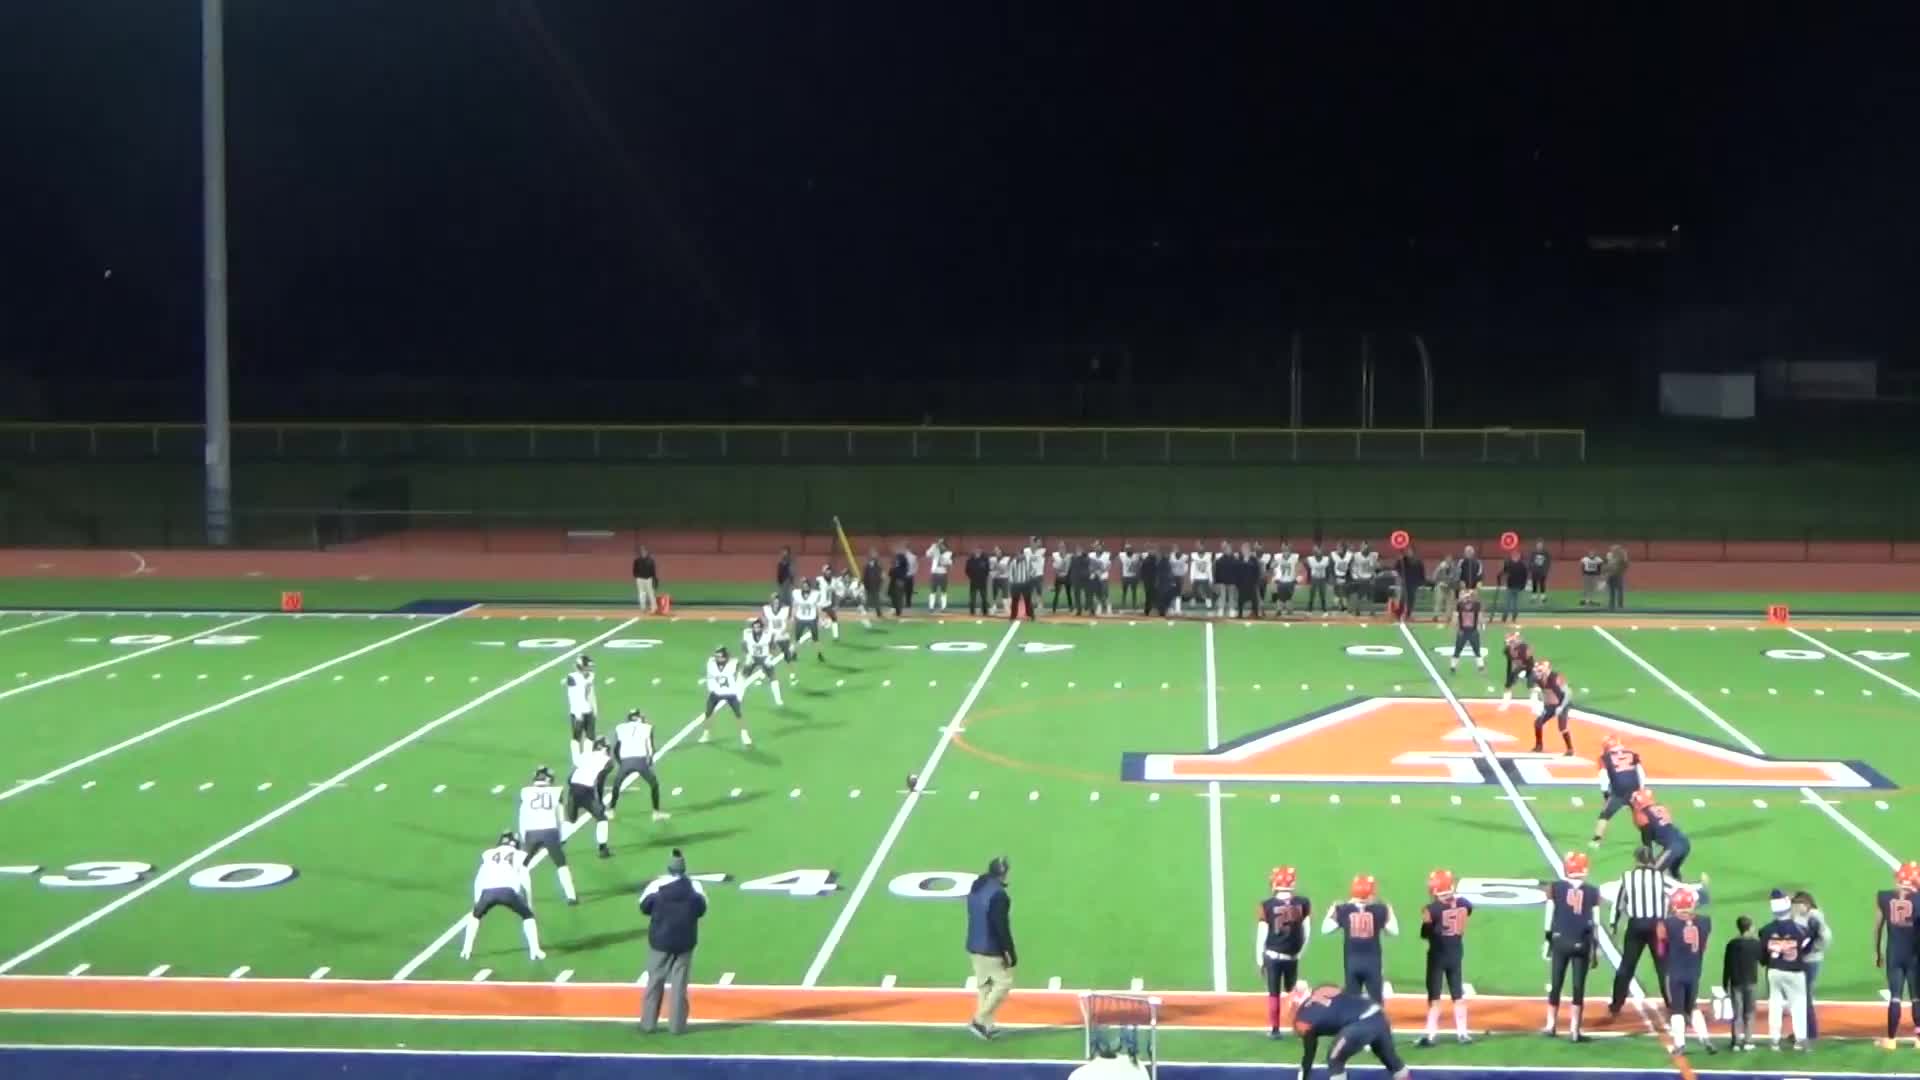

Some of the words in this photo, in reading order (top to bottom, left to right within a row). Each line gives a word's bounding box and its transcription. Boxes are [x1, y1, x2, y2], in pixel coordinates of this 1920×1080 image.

[530, 791, 554, 811] 20
[491, 850, 516, 866] 44
[1566, 887, 1584, 915] 4
[1349, 911, 1375, 938] 10
[1441, 908, 1468, 936] 50
